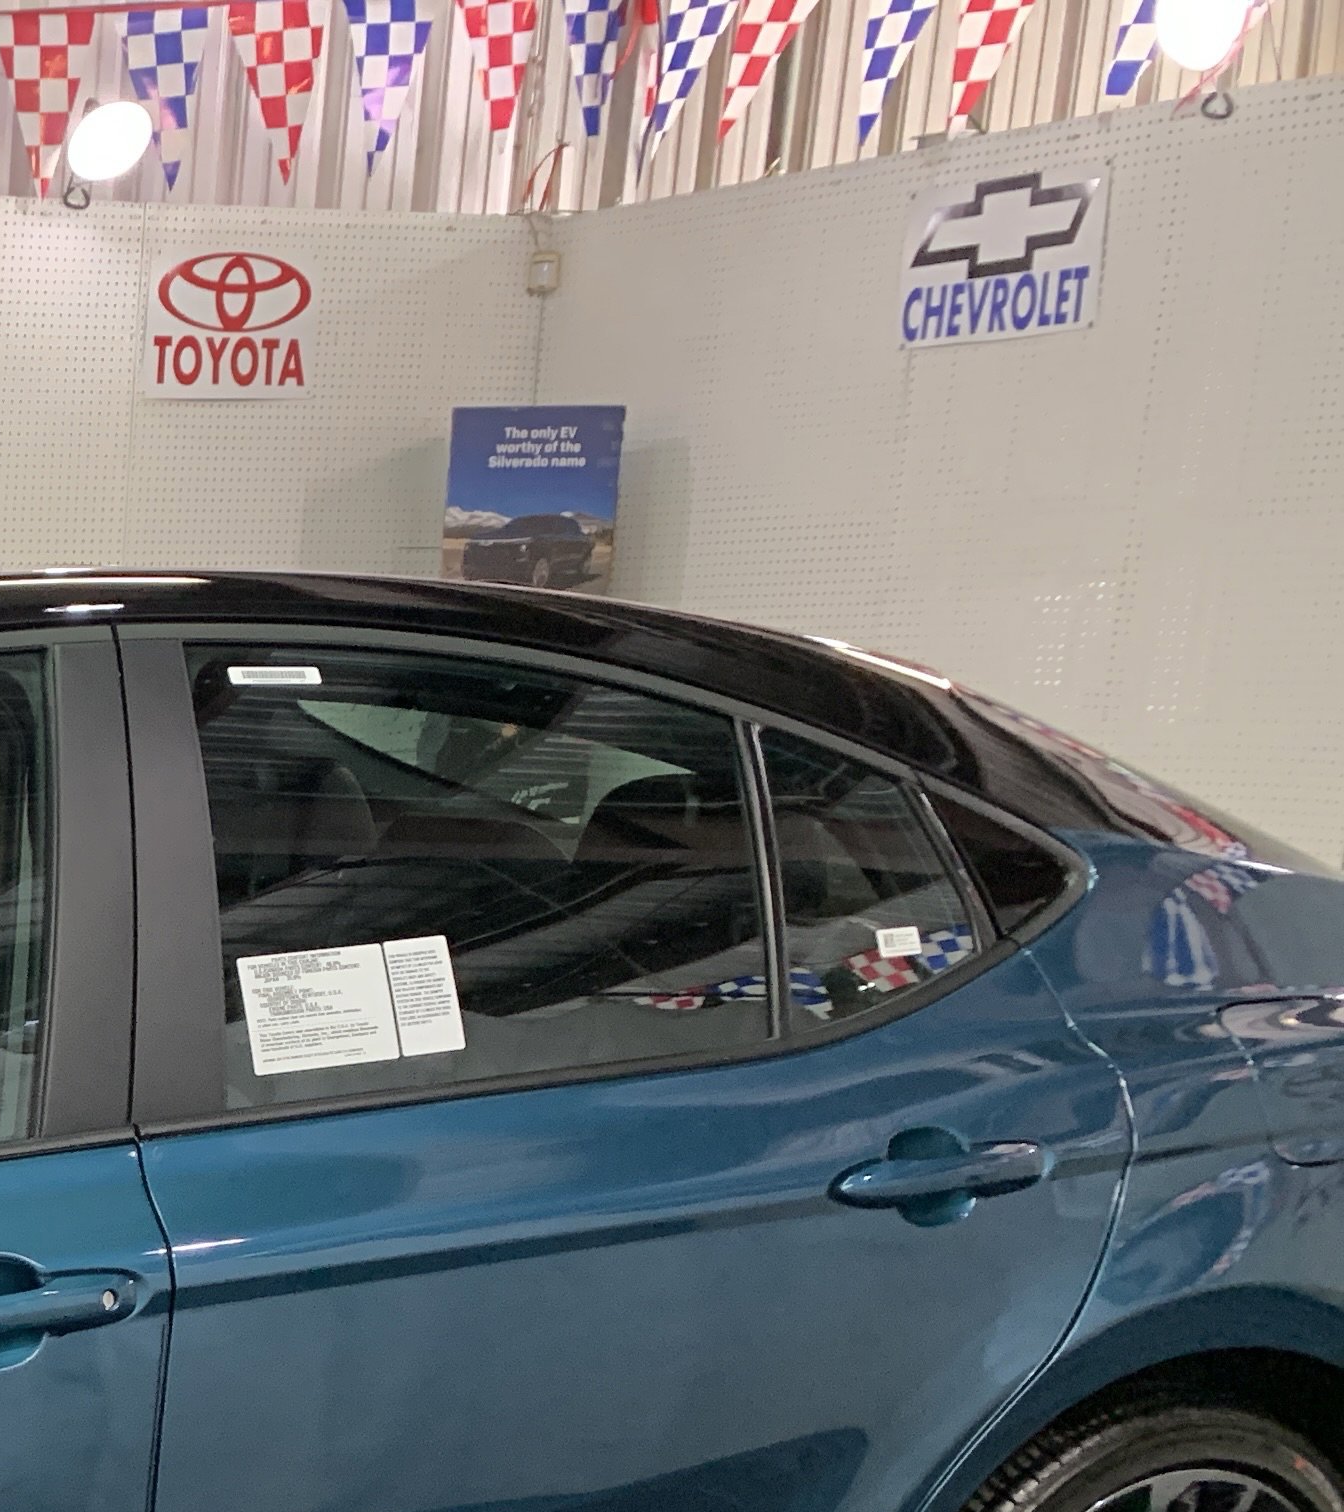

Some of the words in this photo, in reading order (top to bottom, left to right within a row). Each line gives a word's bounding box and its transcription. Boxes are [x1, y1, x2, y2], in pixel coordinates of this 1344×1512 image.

[902, 264, 1091, 343] CHEVROLET
[153, 334, 305, 387] TOYOTA
[504, 426, 529, 439] The
[530, 425, 559, 441] only
[559, 426, 578, 439] EV
[496, 441, 543, 455] worthy
[543, 441, 559, 453] of
[560, 441, 582, 453] the
[488, 455, 549, 468] Silverado
[551, 456, 587, 468] name
